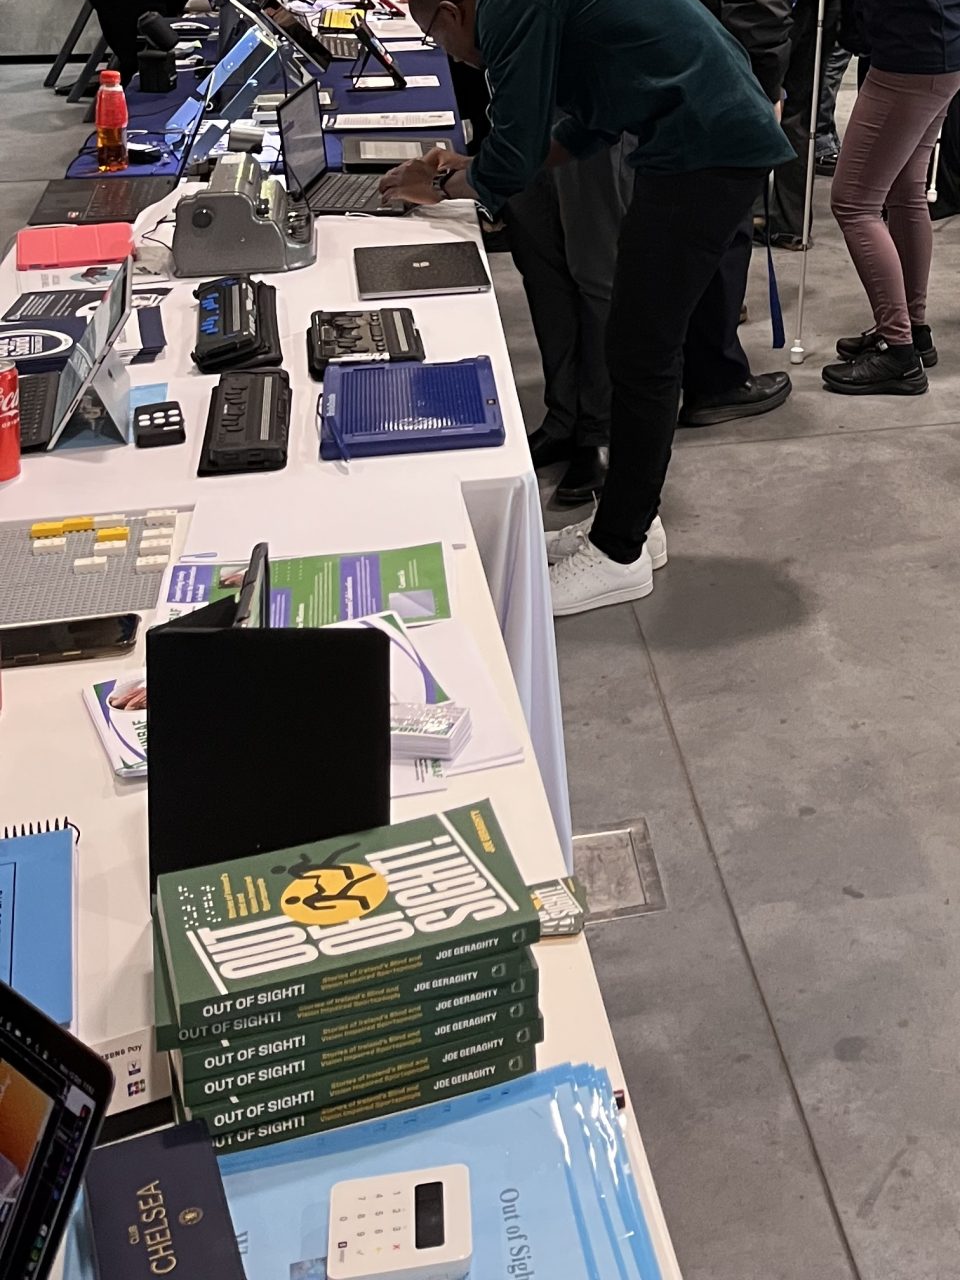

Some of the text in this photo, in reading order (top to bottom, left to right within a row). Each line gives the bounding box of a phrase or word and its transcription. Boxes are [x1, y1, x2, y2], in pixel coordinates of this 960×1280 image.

[365, 834, 507, 932] SIGHT!
[198, 916, 319, 980] OUT
[436, 938, 499, 960] JOE GERAGHTY
[414, 972, 478, 992] JOE GERAGHTY
[202, 984, 306, 1017] OUT OF SIGHT!
[436, 988, 498, 1012] JOE GERAGHTY
[178, 1011, 282, 1040] OUT OF SIGHT!
[434, 1012, 497, 1036] JOE GERAGHTY
[204, 1035, 306, 1068] OUT OF SIGHT!
[442, 1038, 504, 1063] JOE GERAGHTY
[204, 1060, 306, 1094] OUT OF SIGHT!
[433, 1066, 496, 1090] JOE GERAGHTY
[214, 1090, 315, 1126] OUT OF SIGHT!
[212, 1116, 306, 1148] UT OF SIGHT!
[500, 1188, 520, 1222] Out
[136, 1180, 177, 1274] CHELSEA
[506, 1224, 528, 1242] of
